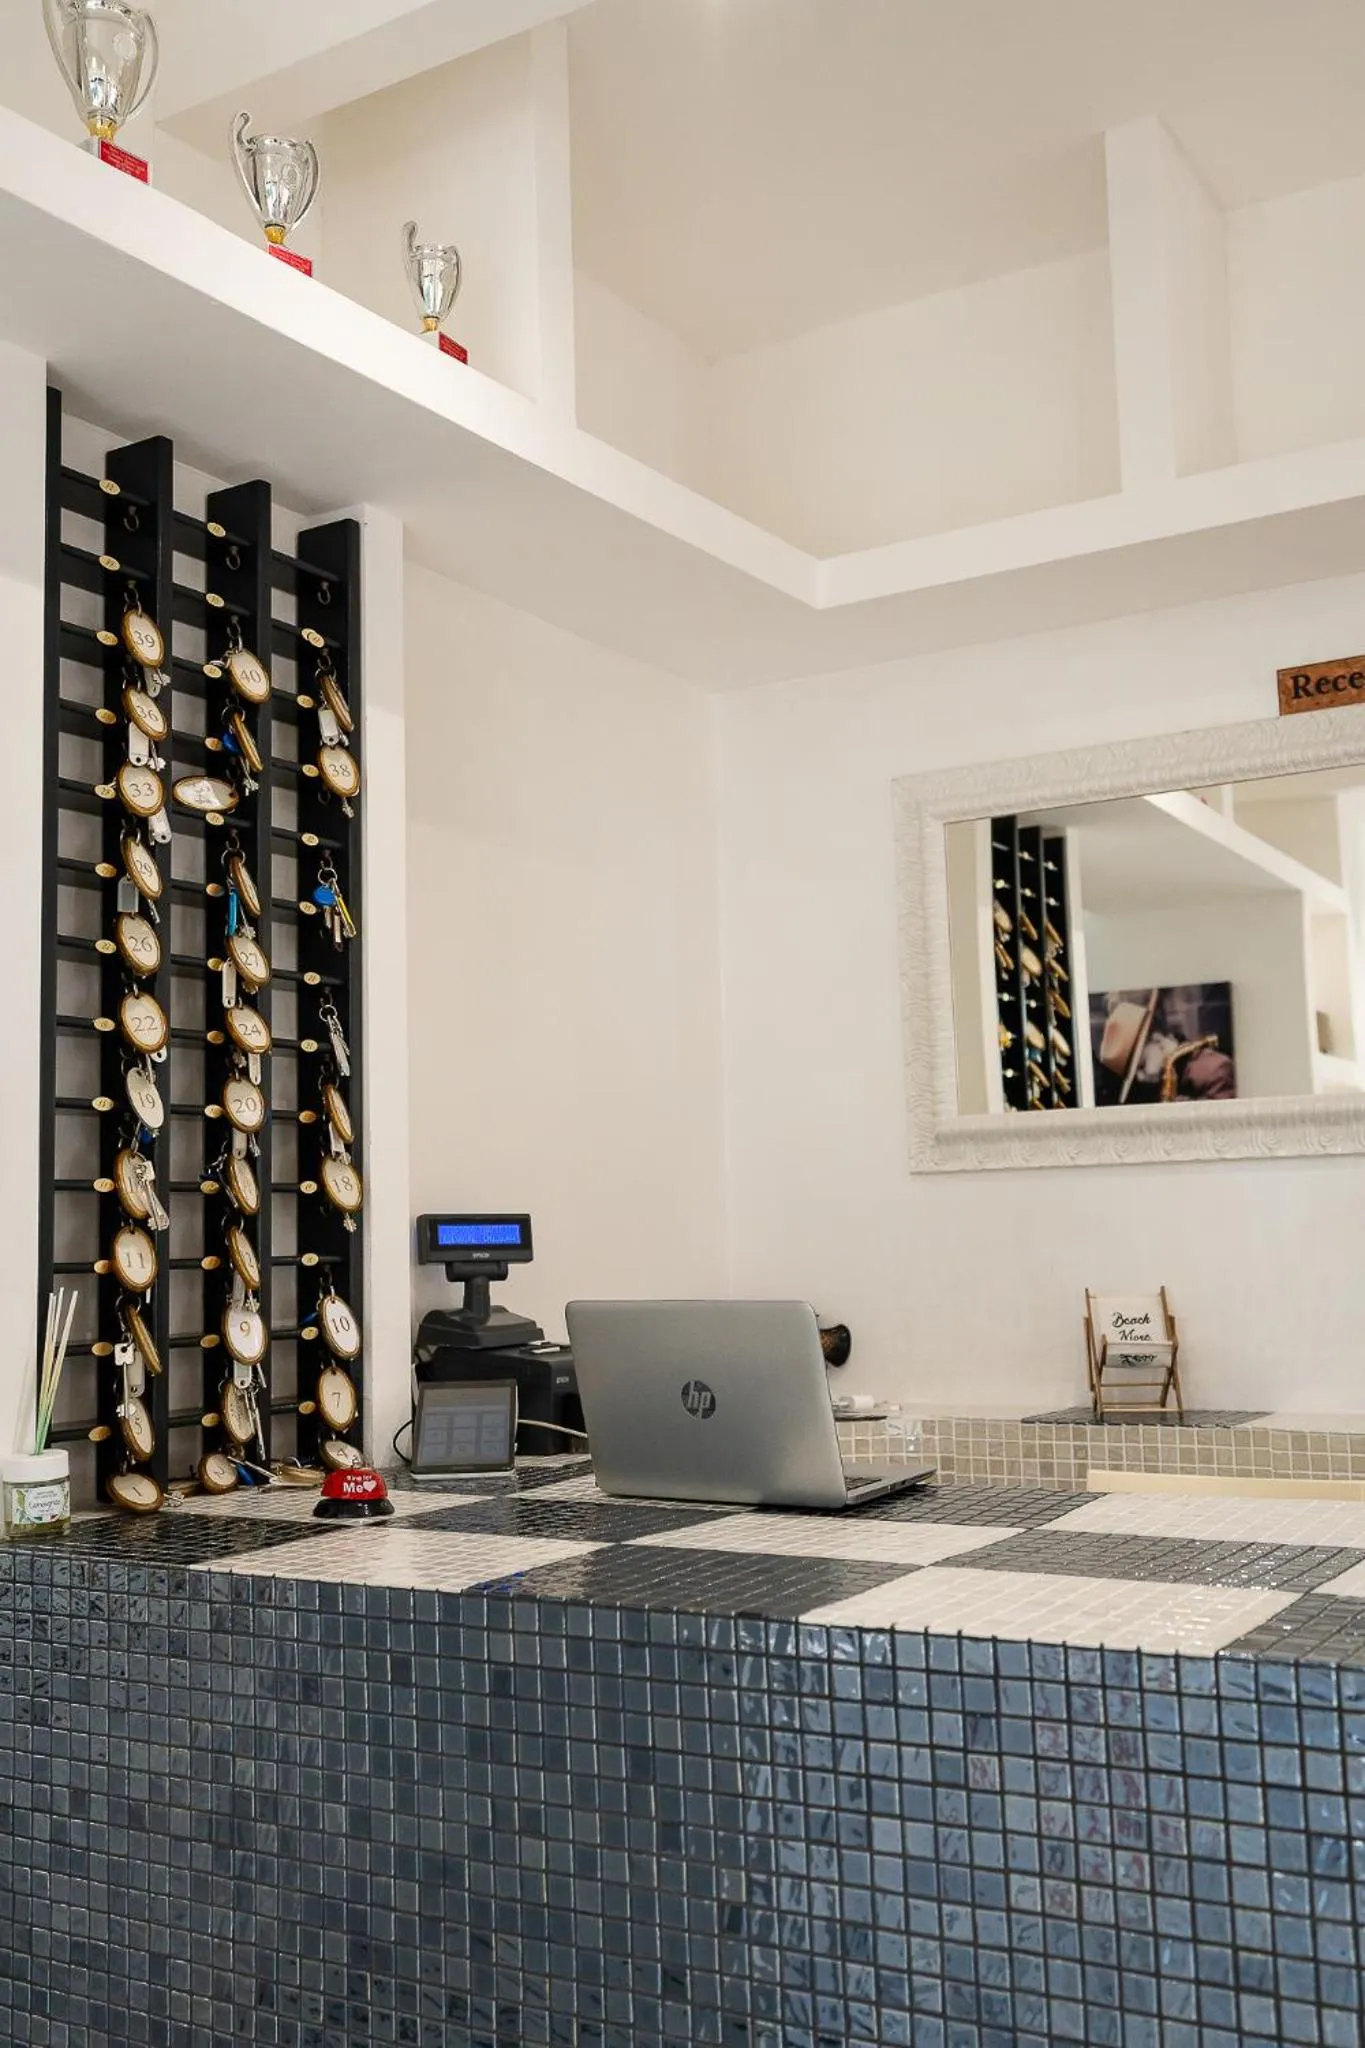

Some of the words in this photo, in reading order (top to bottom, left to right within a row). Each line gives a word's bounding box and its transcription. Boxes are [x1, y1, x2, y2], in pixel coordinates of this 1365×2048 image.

[133, 630, 155, 648] 39
[241, 667, 262, 684] 40
[1290, 671, 1365, 699] Rece
[136, 705, 159, 722] 36
[328, 763, 351, 778] 38
[129, 782, 154, 797] 33
[135, 859, 153, 878] 29
[128, 936, 153, 953] 26
[240, 951, 260, 967] 27
[131, 1015, 158, 1032] 22
[238, 1023, 262, 1037] 24
[137, 1091, 156, 1109] 19
[232, 1097, 257, 1114] 20
[332, 1175, 354, 1193] 18
[126, 1252, 146, 1269] 11
[332, 1315, 351, 1333] 10
[1112, 1311, 1152, 1328] Beach
[239, 1321, 250, 1337] 9
[331, 1391, 341, 1409] 7
[687, 1380, 711, 1419] hp
[336, 1448, 348, 1460] 4
[343, 1482, 364, 1494] Me
